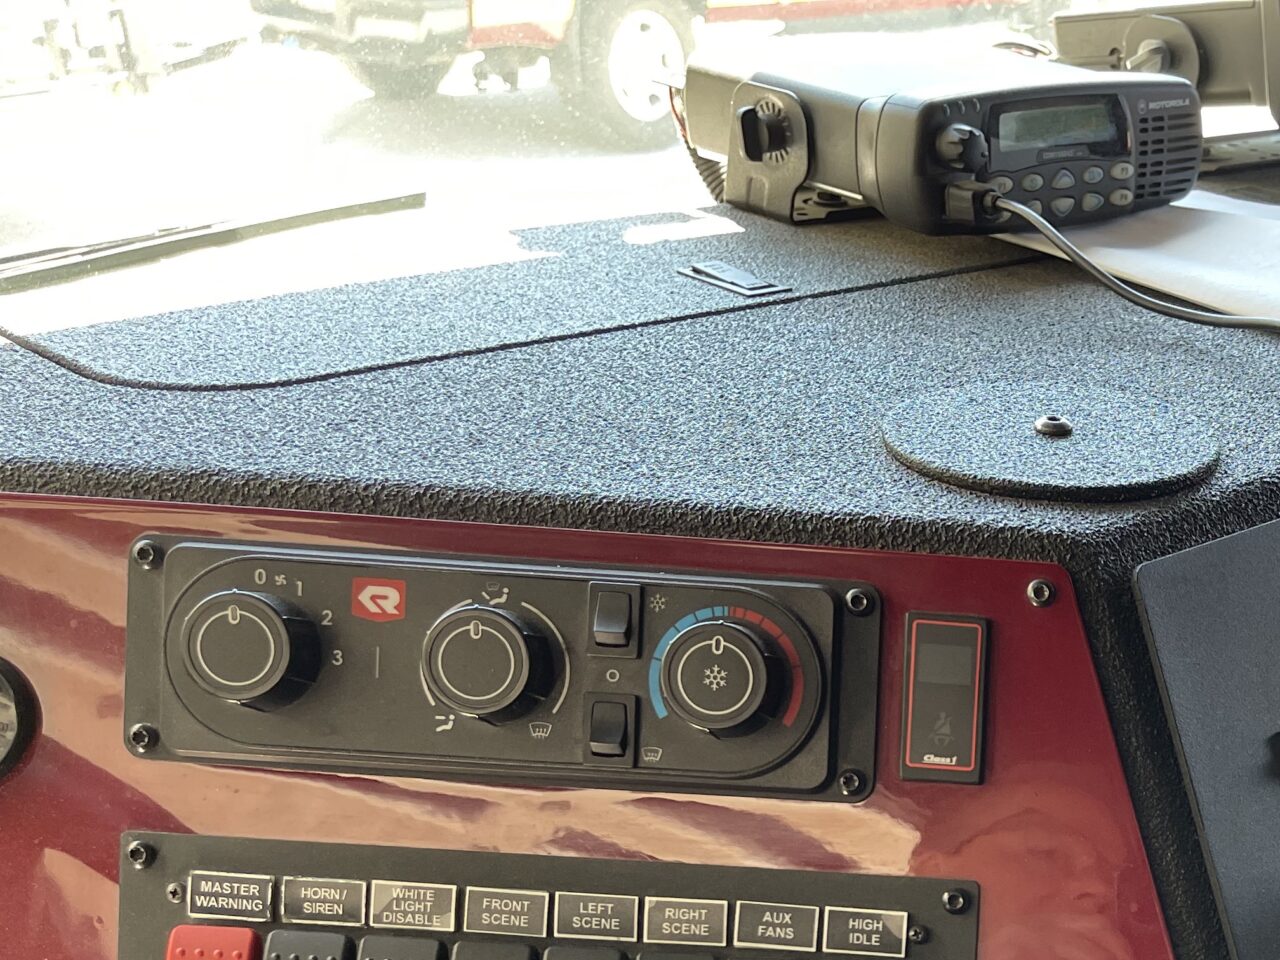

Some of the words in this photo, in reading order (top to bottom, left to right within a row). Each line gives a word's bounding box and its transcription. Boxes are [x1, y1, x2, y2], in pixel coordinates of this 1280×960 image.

[1149, 98, 1190, 110] MOTOROLA
[253, 568, 266, 585] 0
[295, 580, 304, 597] 1
[321, 609, 334, 626] 2
[331, 649, 345, 666] 3
[200, 880, 260, 896] MASTER
[391, 886, 436, 902] WHITE
[194, 895, 264, 911] WARNING
[303, 901, 344, 915] SIREN
[392, 899, 433, 914] LIGHT
[482, 897, 531, 913] FRONT
[579, 901, 614, 916] LEFT
[382, 911, 441, 926] DISABLE
[481, 912, 530, 928] SCENE
[571, 915, 621, 931] SCENE
[664, 907, 708, 923] RIGHT
[762, 910, 792, 925] AUX
[661, 921, 710, 936] SCENE
[757, 924, 795, 940] FANS
[848, 917, 884, 932] HIGH
[849, 931, 881, 946] IDLE
